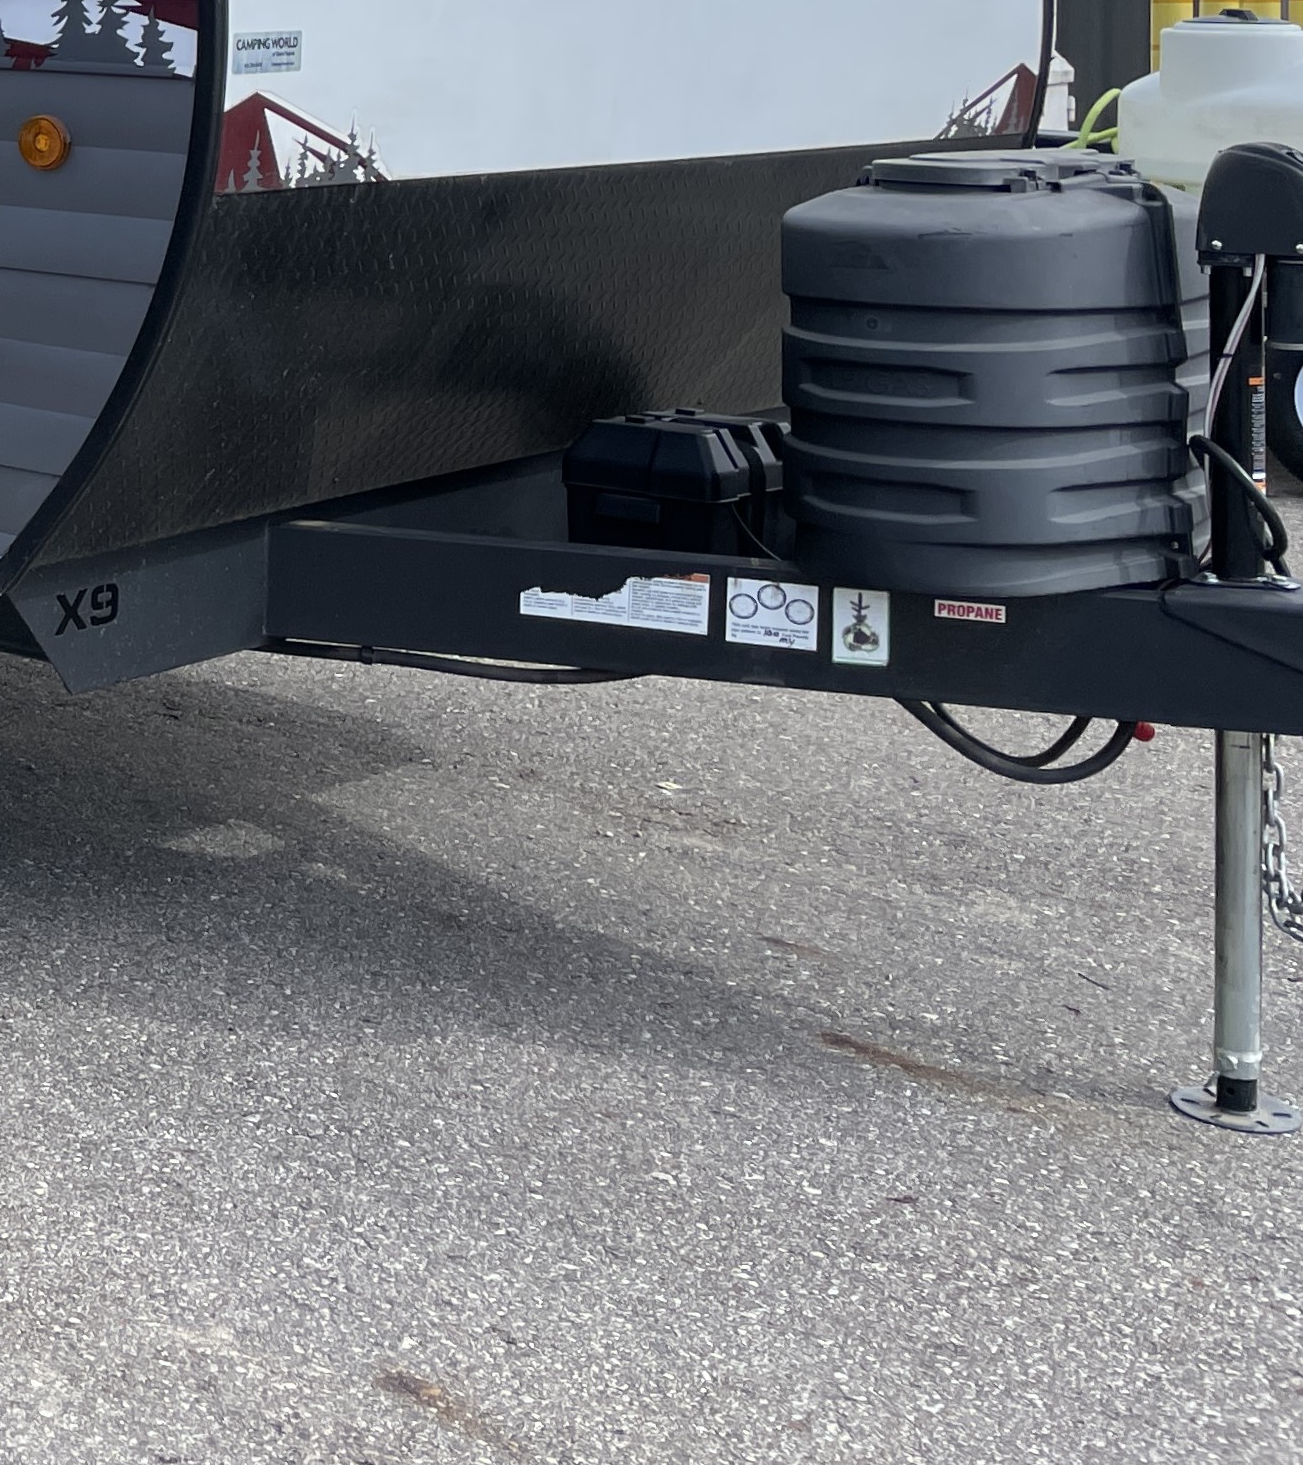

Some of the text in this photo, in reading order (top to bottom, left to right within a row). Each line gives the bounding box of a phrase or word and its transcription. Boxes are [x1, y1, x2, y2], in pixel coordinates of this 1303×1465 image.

[236, 36, 299, 51] CAMPING WORLD
[54, 582, 120, 636] X9
[937, 602, 1004, 621] PROPANE
